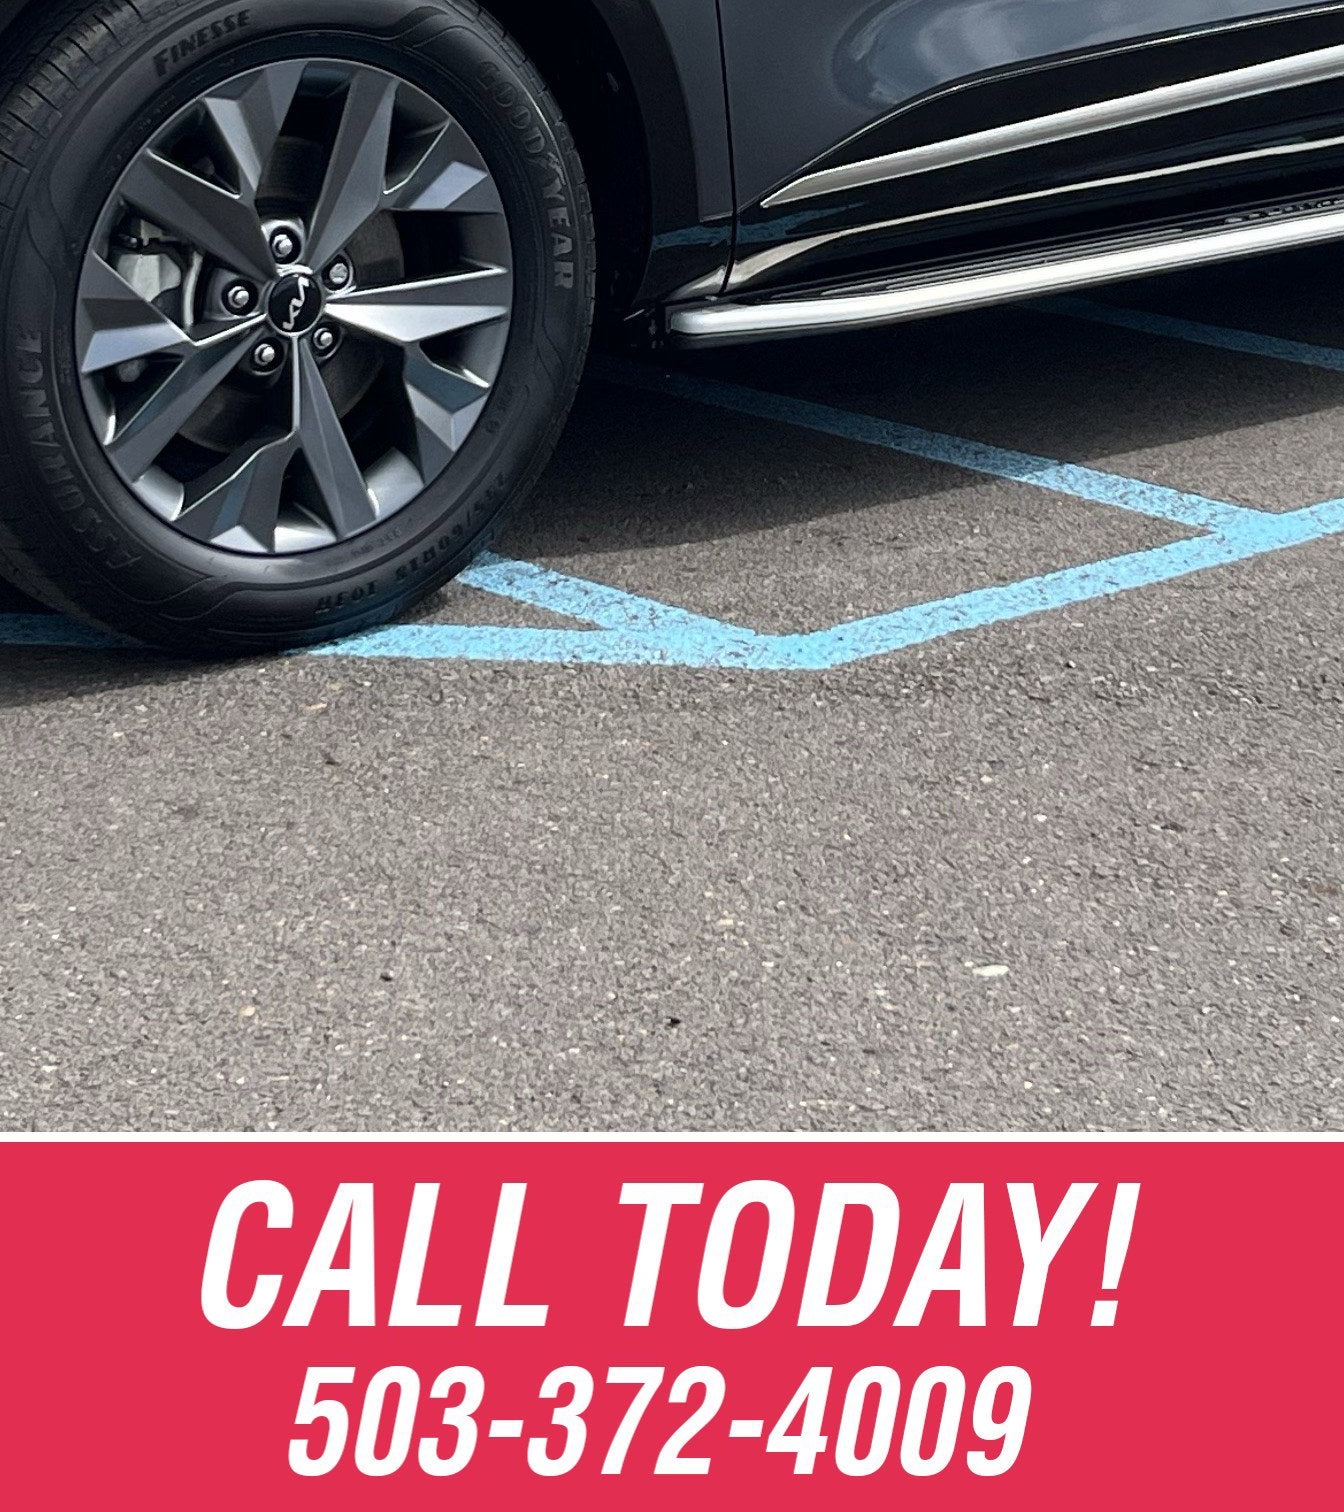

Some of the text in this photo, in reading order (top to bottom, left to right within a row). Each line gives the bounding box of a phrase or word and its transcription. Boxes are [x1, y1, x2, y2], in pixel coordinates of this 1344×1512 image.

[153, 8, 250, 77] FINESSE
[475, 60, 575, 290] GOODYEAR
[16, 331, 143, 569] ASSURANCE
